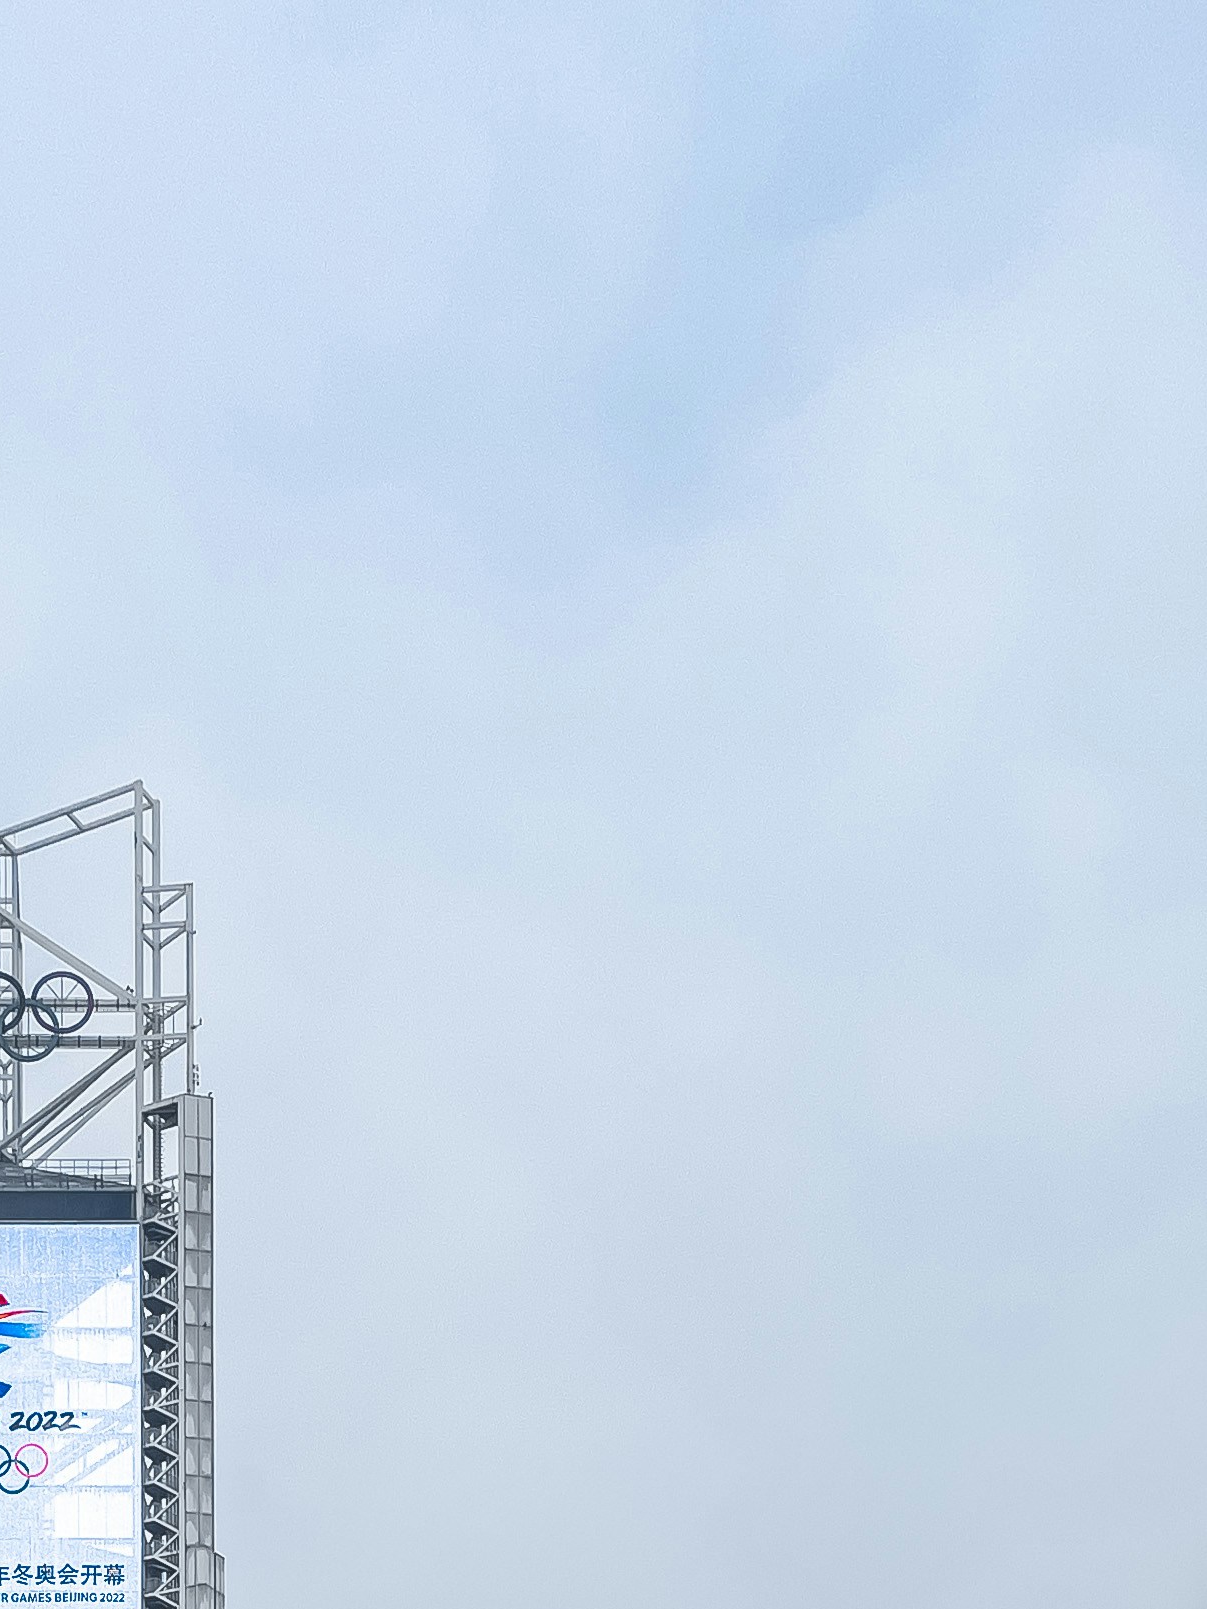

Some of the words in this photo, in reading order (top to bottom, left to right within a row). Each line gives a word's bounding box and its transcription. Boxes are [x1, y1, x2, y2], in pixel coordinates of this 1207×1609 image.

[9, 1411, 81, 1431] 2022
[11, 1592, 52, 1603] GAMES
[54, 1592, 98, 1603] BEIJING
[99, 1592, 125, 1603] 2022
